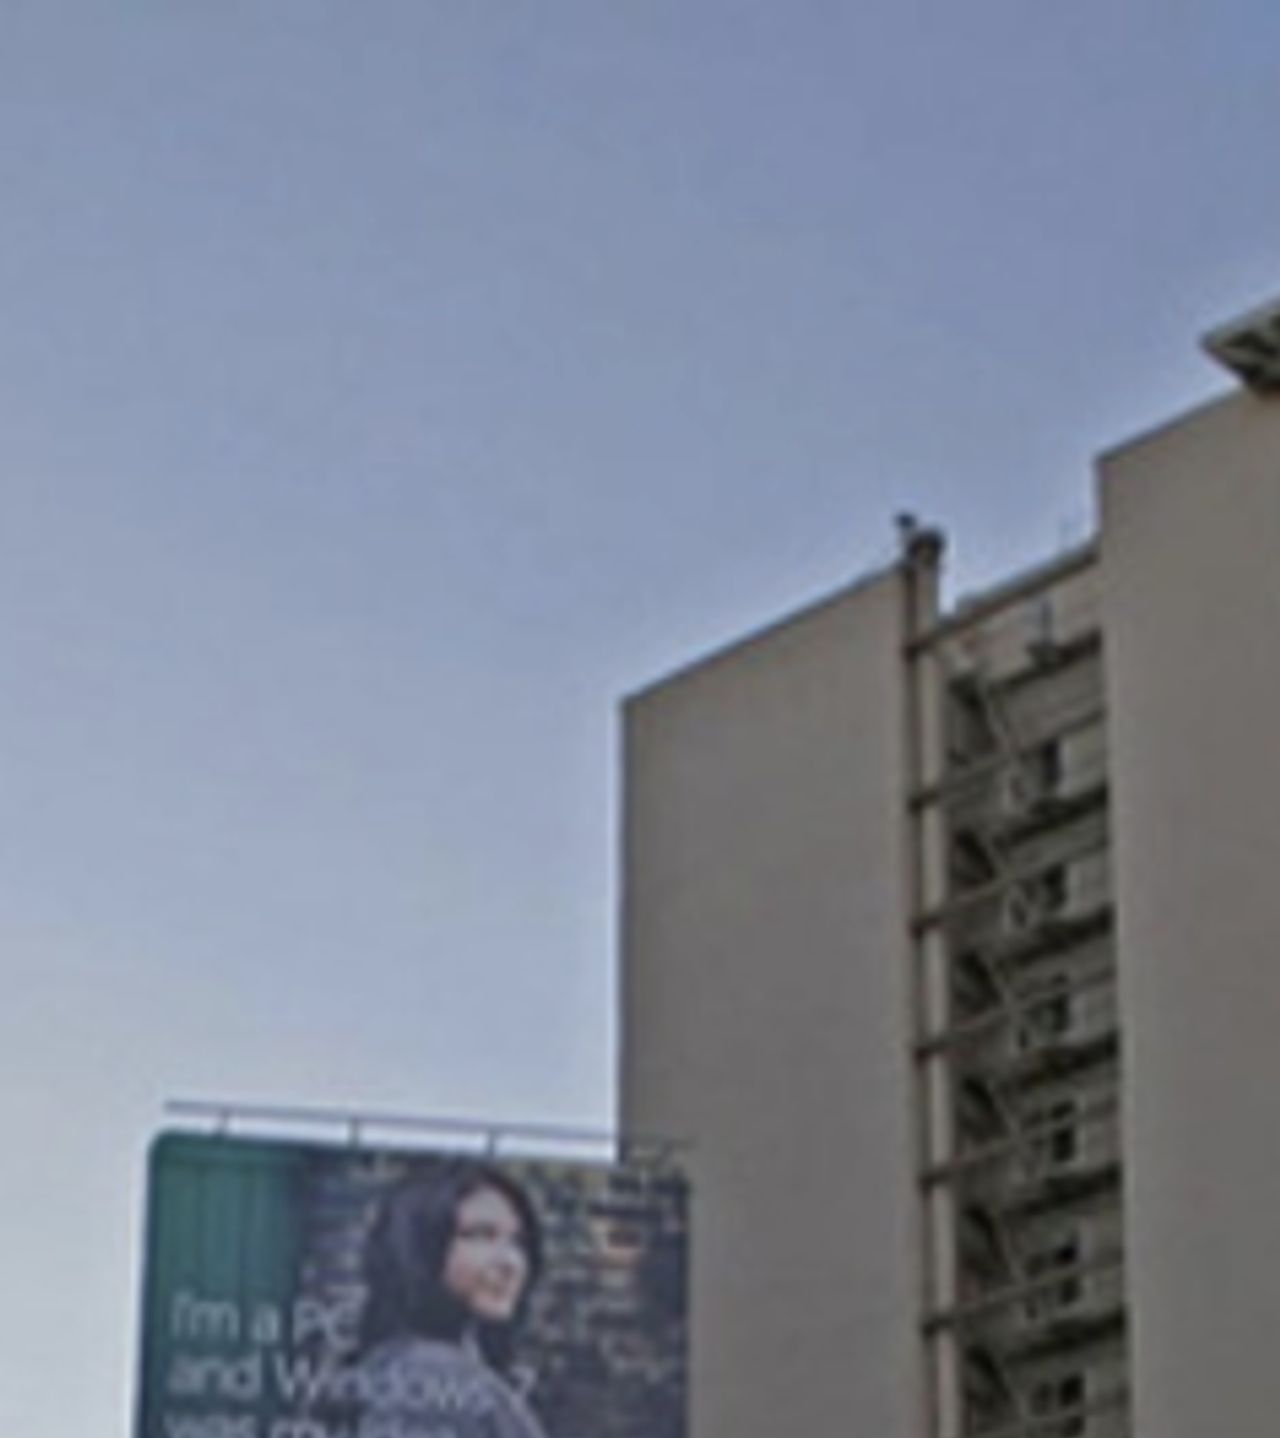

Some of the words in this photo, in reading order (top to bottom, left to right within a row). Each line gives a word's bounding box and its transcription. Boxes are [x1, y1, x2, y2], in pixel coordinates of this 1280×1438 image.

[170, 1292, 238, 1338] I'm
[248, 1309, 278, 1343] a
[166, 1350, 261, 1397] and
